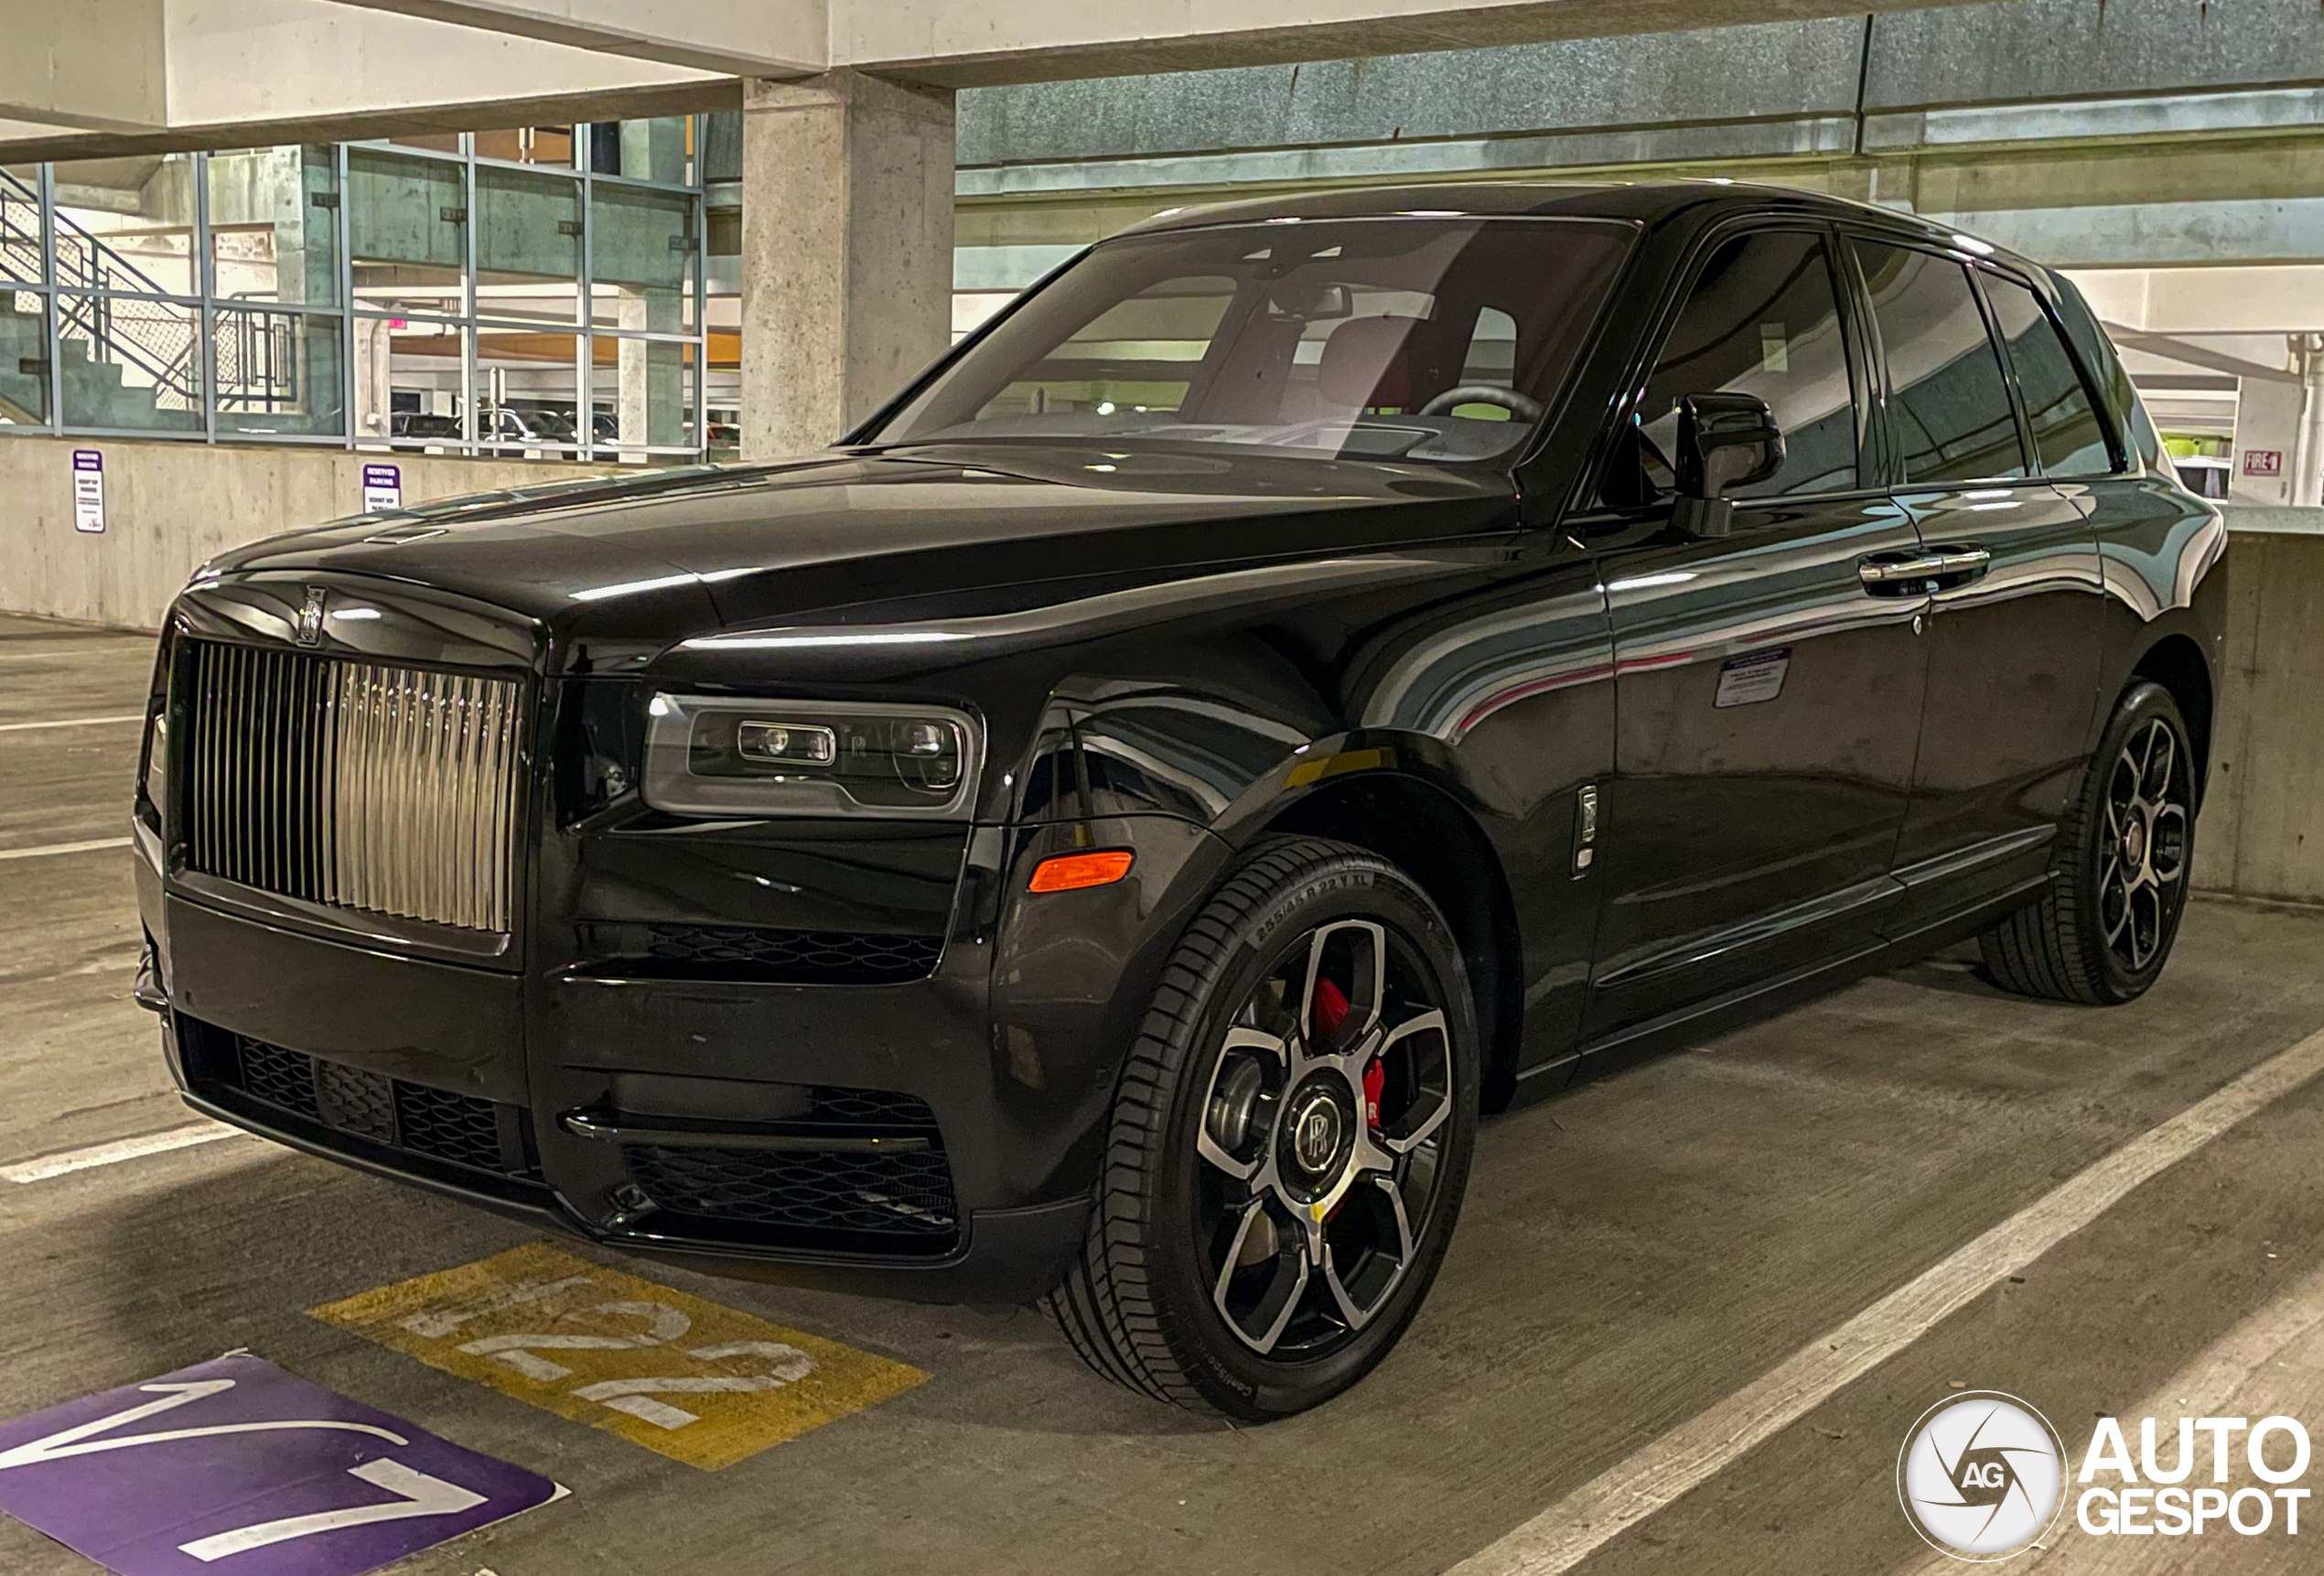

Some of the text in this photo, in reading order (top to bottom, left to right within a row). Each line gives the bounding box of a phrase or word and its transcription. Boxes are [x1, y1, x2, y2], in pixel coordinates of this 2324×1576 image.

[2246, 453, 2268, 469] FIRE
[367, 467, 395, 477] RESERVED
[370, 477, 393, 486] PARKING
[1306, 886, 1316, 897] R
[1318, 878, 1338, 893] 22
[1352, 874, 1368, 885] XL
[401, 1276, 816, 1431] 122
